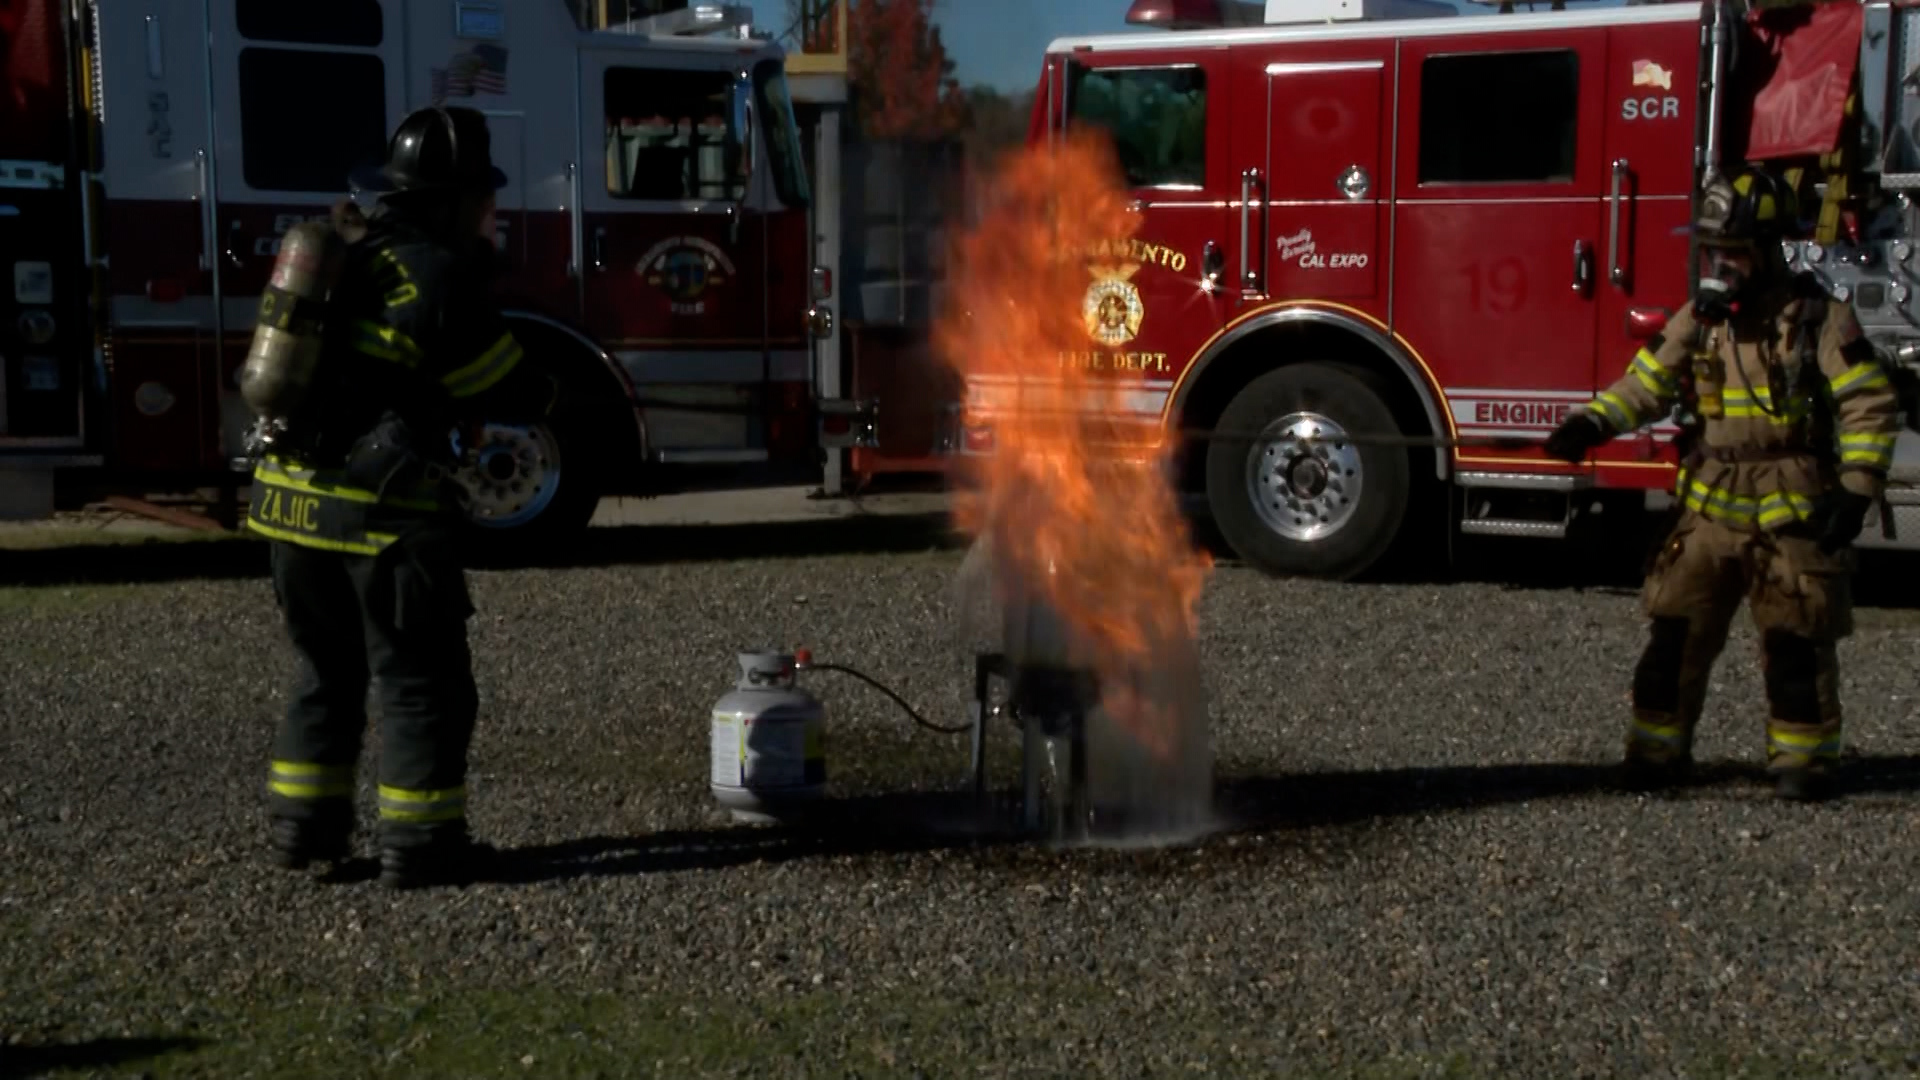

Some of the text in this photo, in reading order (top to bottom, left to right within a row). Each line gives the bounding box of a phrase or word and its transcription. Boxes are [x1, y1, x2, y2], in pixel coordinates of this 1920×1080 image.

[1621, 96, 1679, 120] SCR
[1298, 252, 1369, 268] CAL EXPO
[1461, 256, 1528, 314] 19
[1113, 352, 1171, 372] DEPT.
[1475, 403, 1570, 423] ENGINE
[259, 487, 320, 532] ZAJIC
